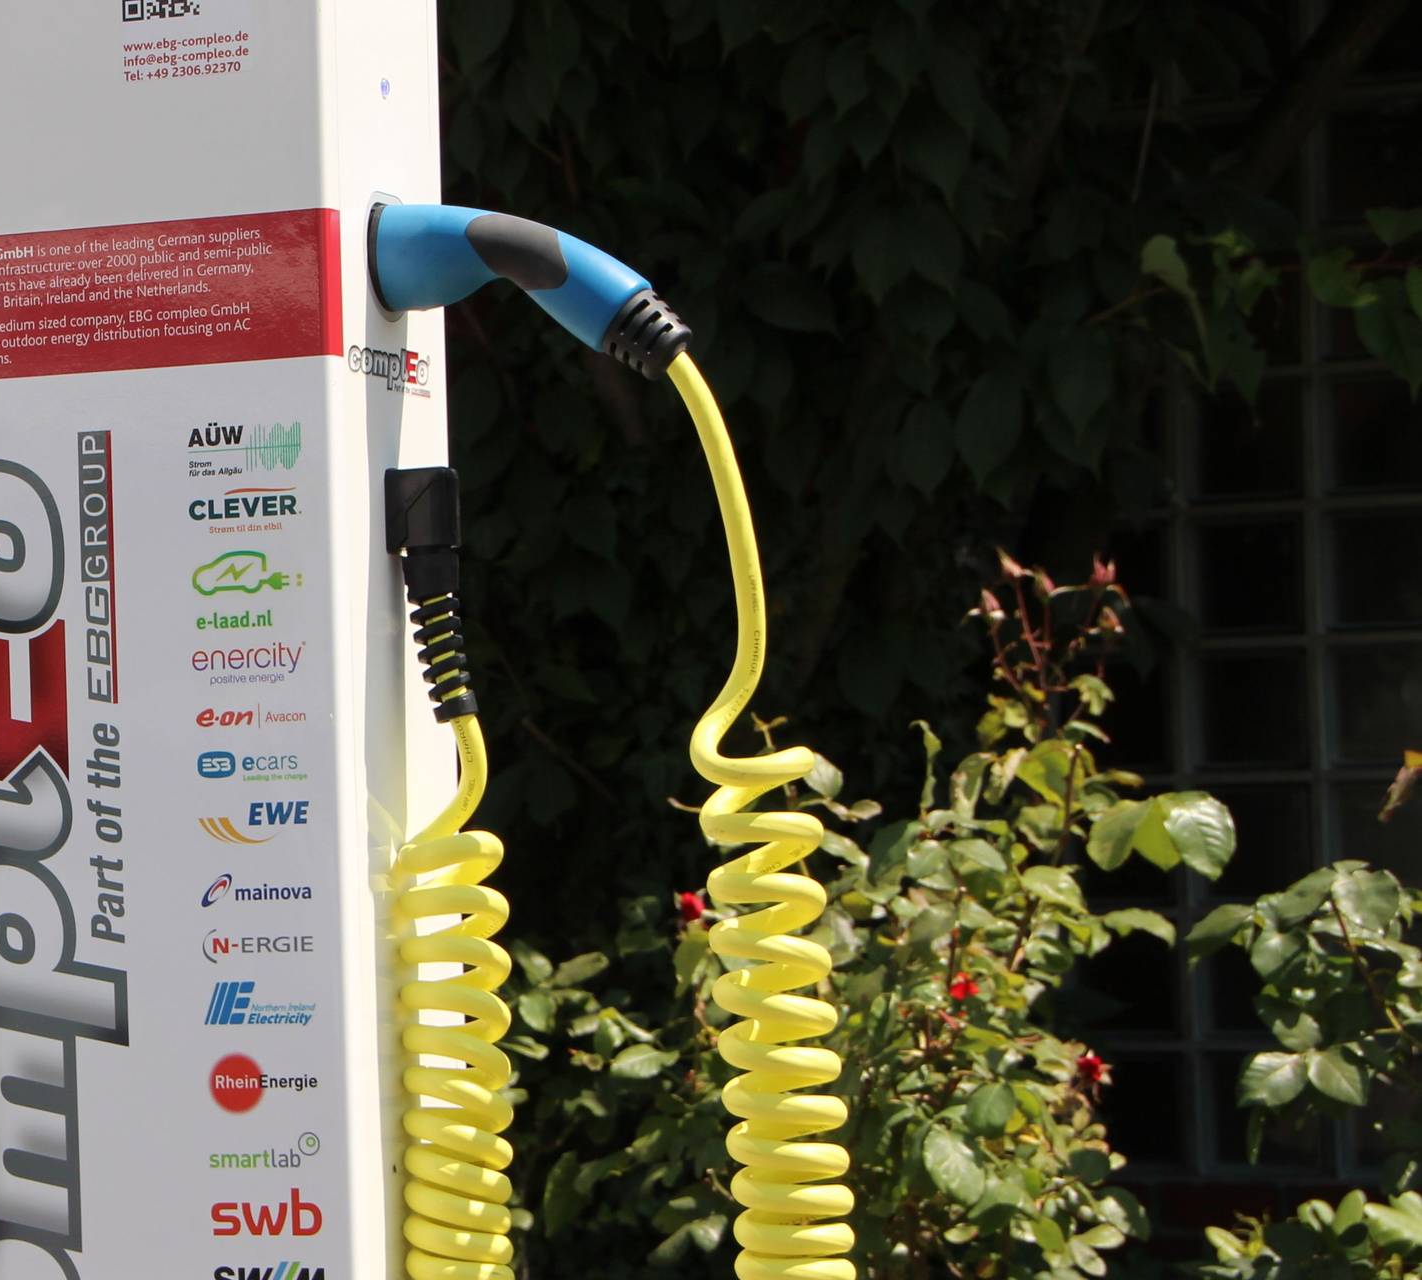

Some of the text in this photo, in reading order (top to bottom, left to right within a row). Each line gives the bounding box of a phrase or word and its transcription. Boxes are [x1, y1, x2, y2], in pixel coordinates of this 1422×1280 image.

[123, 31, 249, 51] www.ebg-compleo.de
[123, 46, 249, 67] info@ebg-compleo.de
[124, 61, 241, 82] Tel: +49 2306.92370
[37, 246, 46, 257] is
[50, 245, 70, 256] one
[74, 241, 86, 254] of
[89, 240, 109, 253] the
[112, 237, 155, 251] leading
[157, 232, 205, 247] German
[209, 228, 260, 245] suppliers
[78, 258, 103, 270] over
[106, 254, 137, 268] 2000
[140, 250, 175, 267] public
[178, 248, 200, 261] and
[203, 243, 273, 260] semi-public
[19, 278, 46, 291] have
[49, 274, 91, 289] already
[94, 272, 123, 285] been
[126, 267, 179, 283] delivered
[182, 266, 194, 277] in
[3, 294, 43, 308] Britain,
[46, 290, 85, 304] Ireland
[89, 288, 110, 301] and
[114, 286, 133, 299] the
[137, 281, 211, 297] Netherlands.
[38, 316, 67, 330] sized
[70, 313, 126, 328] company,
[129, 309, 153, 323] EBG
[156, 306, 207, 322] compleo
[211, 302, 250, 316] GmbH
[2, 334, 46, 348] outdoor
[51, 332, 90, 346] energy
[93, 326, 160, 341] distribution
[164, 322, 213, 337] focusing
[216, 321, 231, 332] on
[234, 318, 251, 330] AC
[188, 422, 244, 447] AÜW
[189, 461, 212, 469] Strom
[189, 469, 200, 477] für
[202, 468, 215, 476] das
[196, 609, 273, 630] e-laad.nl
[209, 672, 285, 686] positive energie
[265, 711, 306, 723] Avacon
[86, 722, 121, 789] the
[242, 754, 298, 771] ecars
[87, 798, 123, 843] of
[248, 801, 309, 826] EWE
[90, 855, 126, 943] Part
[235, 883, 312, 901] mainova
[252, 1002, 316, 1012] Northern Ireland
[248, 1012, 312, 1026] Electricity
[209, 1149, 301, 1169] smartlab
[211, 1187, 322, 1236] swb
